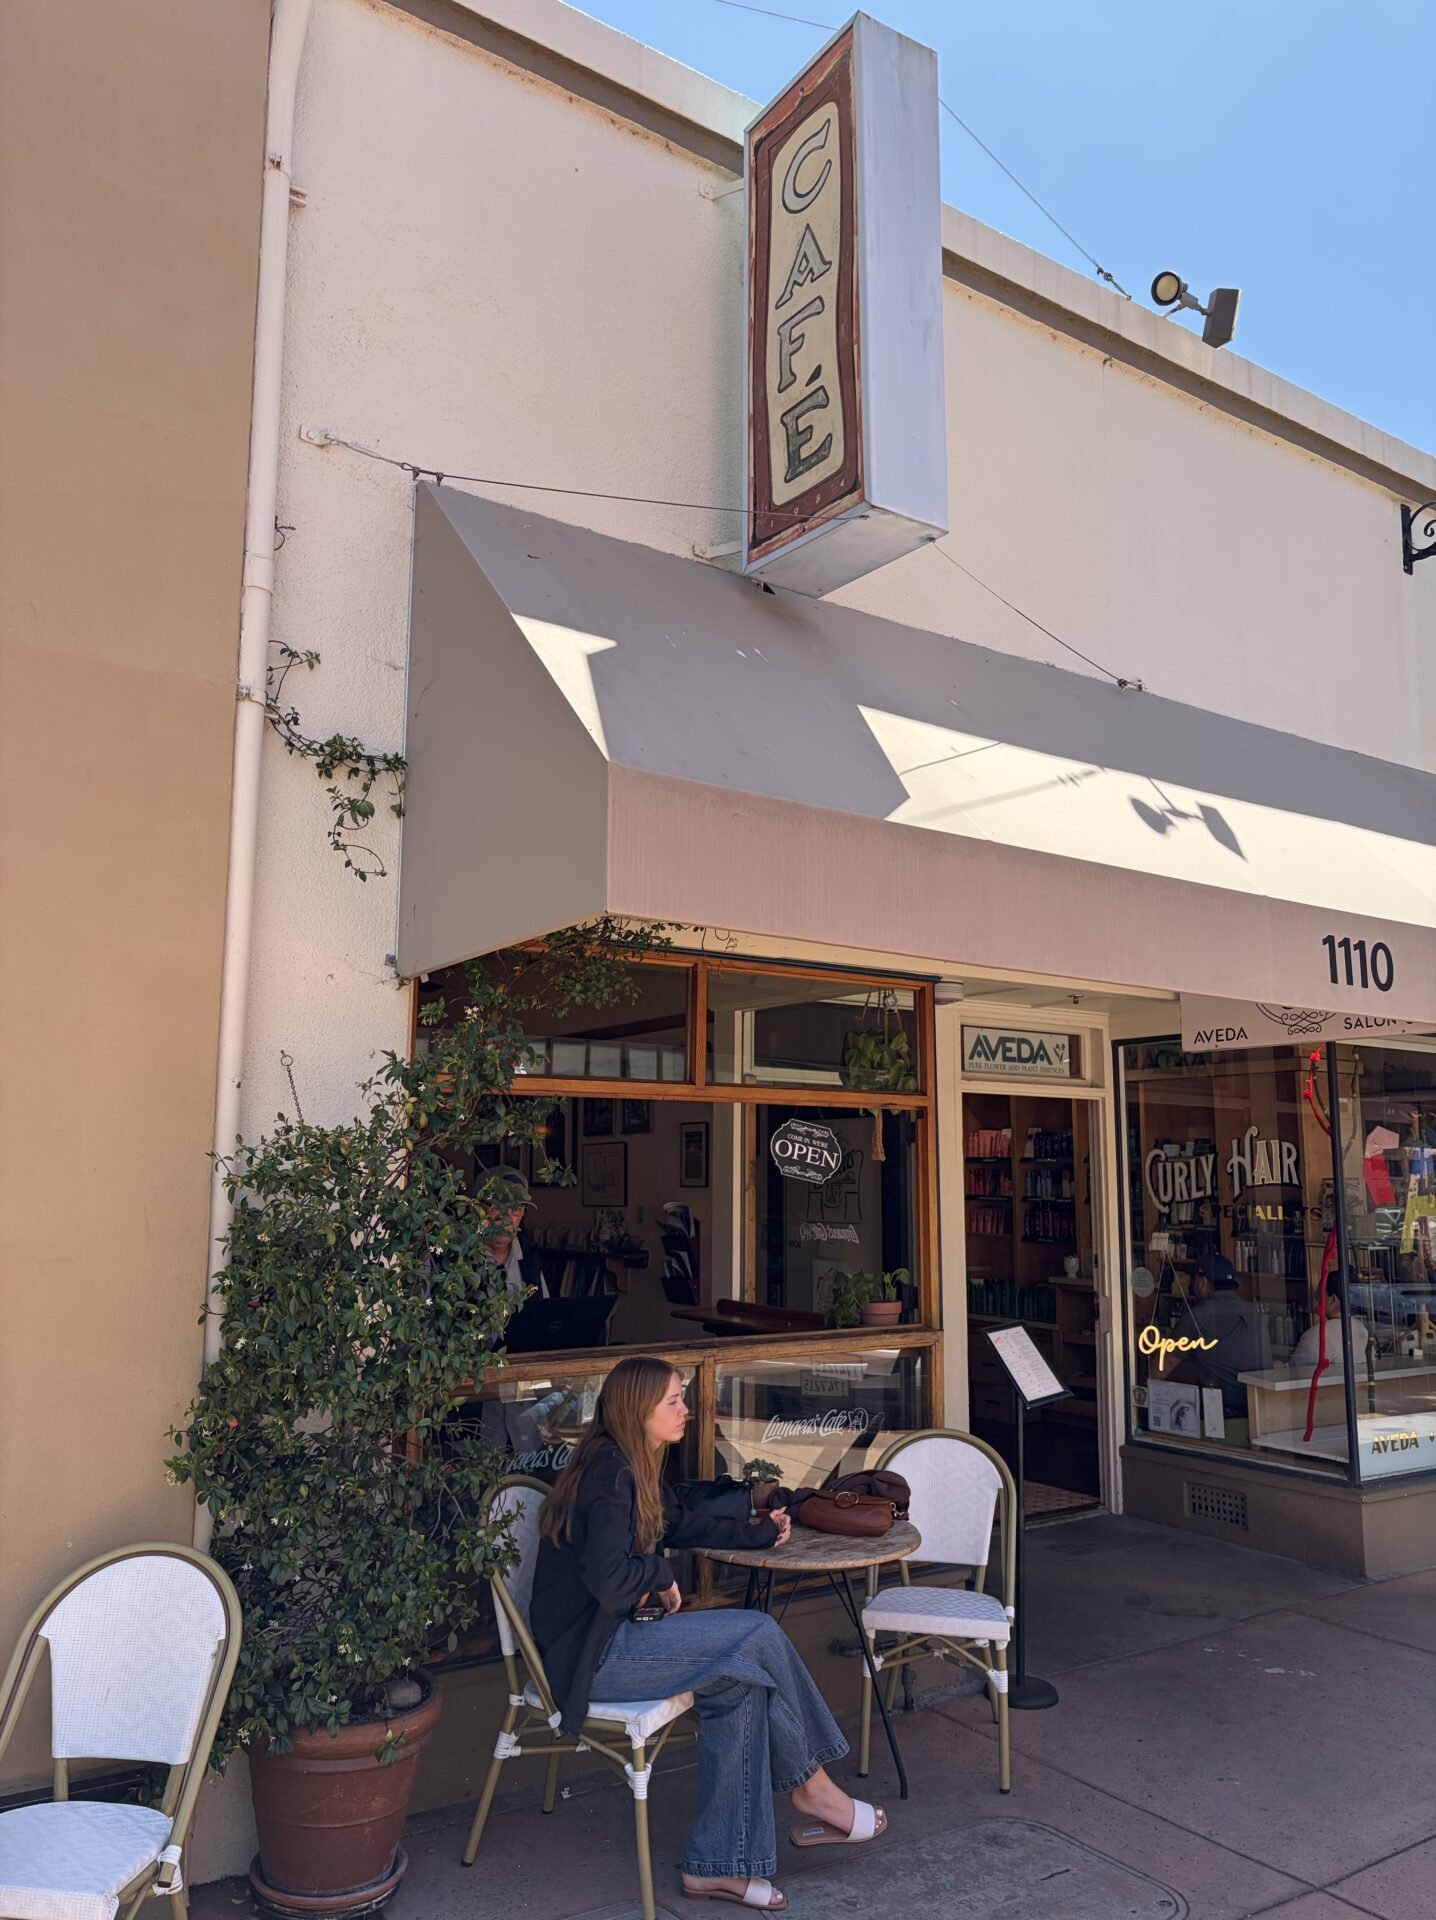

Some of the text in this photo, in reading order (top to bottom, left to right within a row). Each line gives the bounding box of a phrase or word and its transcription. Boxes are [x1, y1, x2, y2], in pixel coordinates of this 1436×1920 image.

[774, 117, 833, 484] CAFÉ
[1322, 934, 1394, 992] 1110
[1193, 1026, 1249, 1046] AVEDA
[1343, 1016, 1397, 1031] SALON
[968, 1033, 1053, 1065] AVEDA
[968, 1061, 983, 1069] PURE
[984, 1062, 1007, 1071] FLOWER
[1008, 1064, 1020, 1072] AND
[1021, 1065, 1039, 1073] PLANT
[787, 1133, 804, 1143] COME
[775, 1139, 839, 1170] OPEN
[1144, 1126, 1301, 1214] CURLY HAIR
[1138, 1325, 1219, 1372] Open
[761, 1409, 848, 1444] Linnaea's Café
[1371, 1431, 1420, 1455] AVEDA
